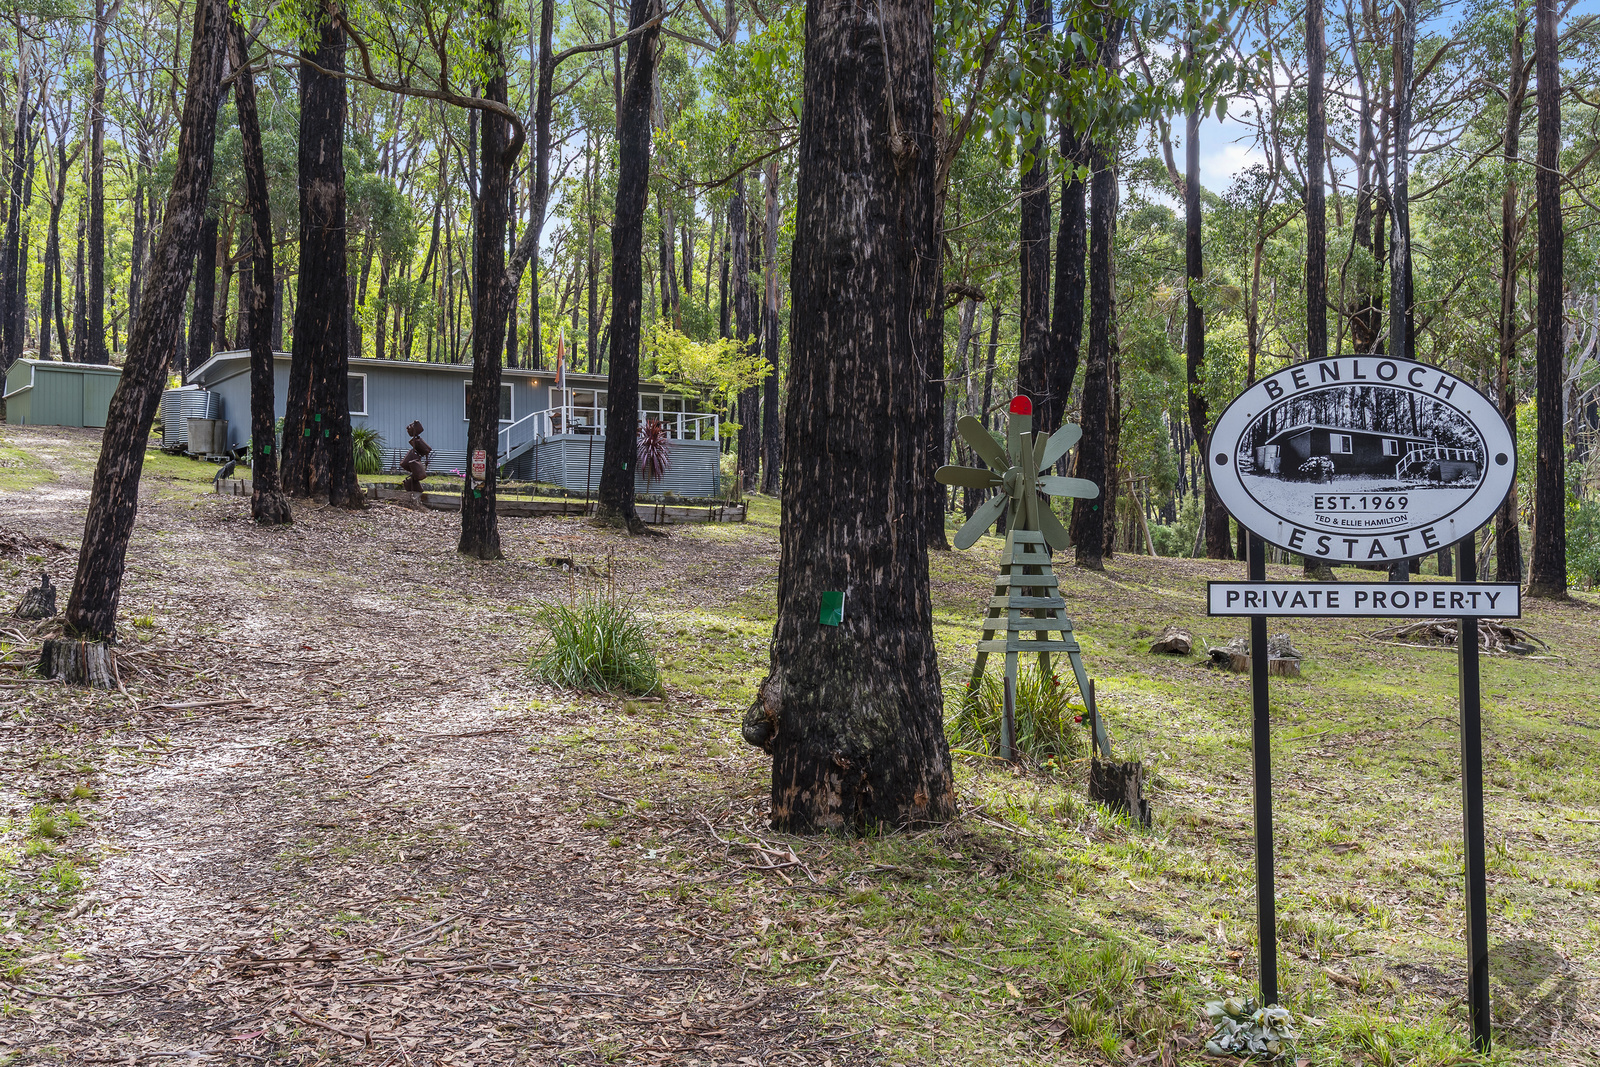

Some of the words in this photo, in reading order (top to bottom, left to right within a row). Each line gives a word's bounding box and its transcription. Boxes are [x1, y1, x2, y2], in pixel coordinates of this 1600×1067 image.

[1263, 360, 1458, 401] BENLOCH
[1315, 513, 1331, 524] TED
[1332, 517, 1339, 525] &
[1341, 519, 1362, 527] ELLIE
[1364, 514, 1408, 526] HAMILTON
[1287, 526, 1441, 560] ESTATE
[1226, 590, 1340, 608] PRIVATE
[1354, 590, 1502, 609] PROPERTY
